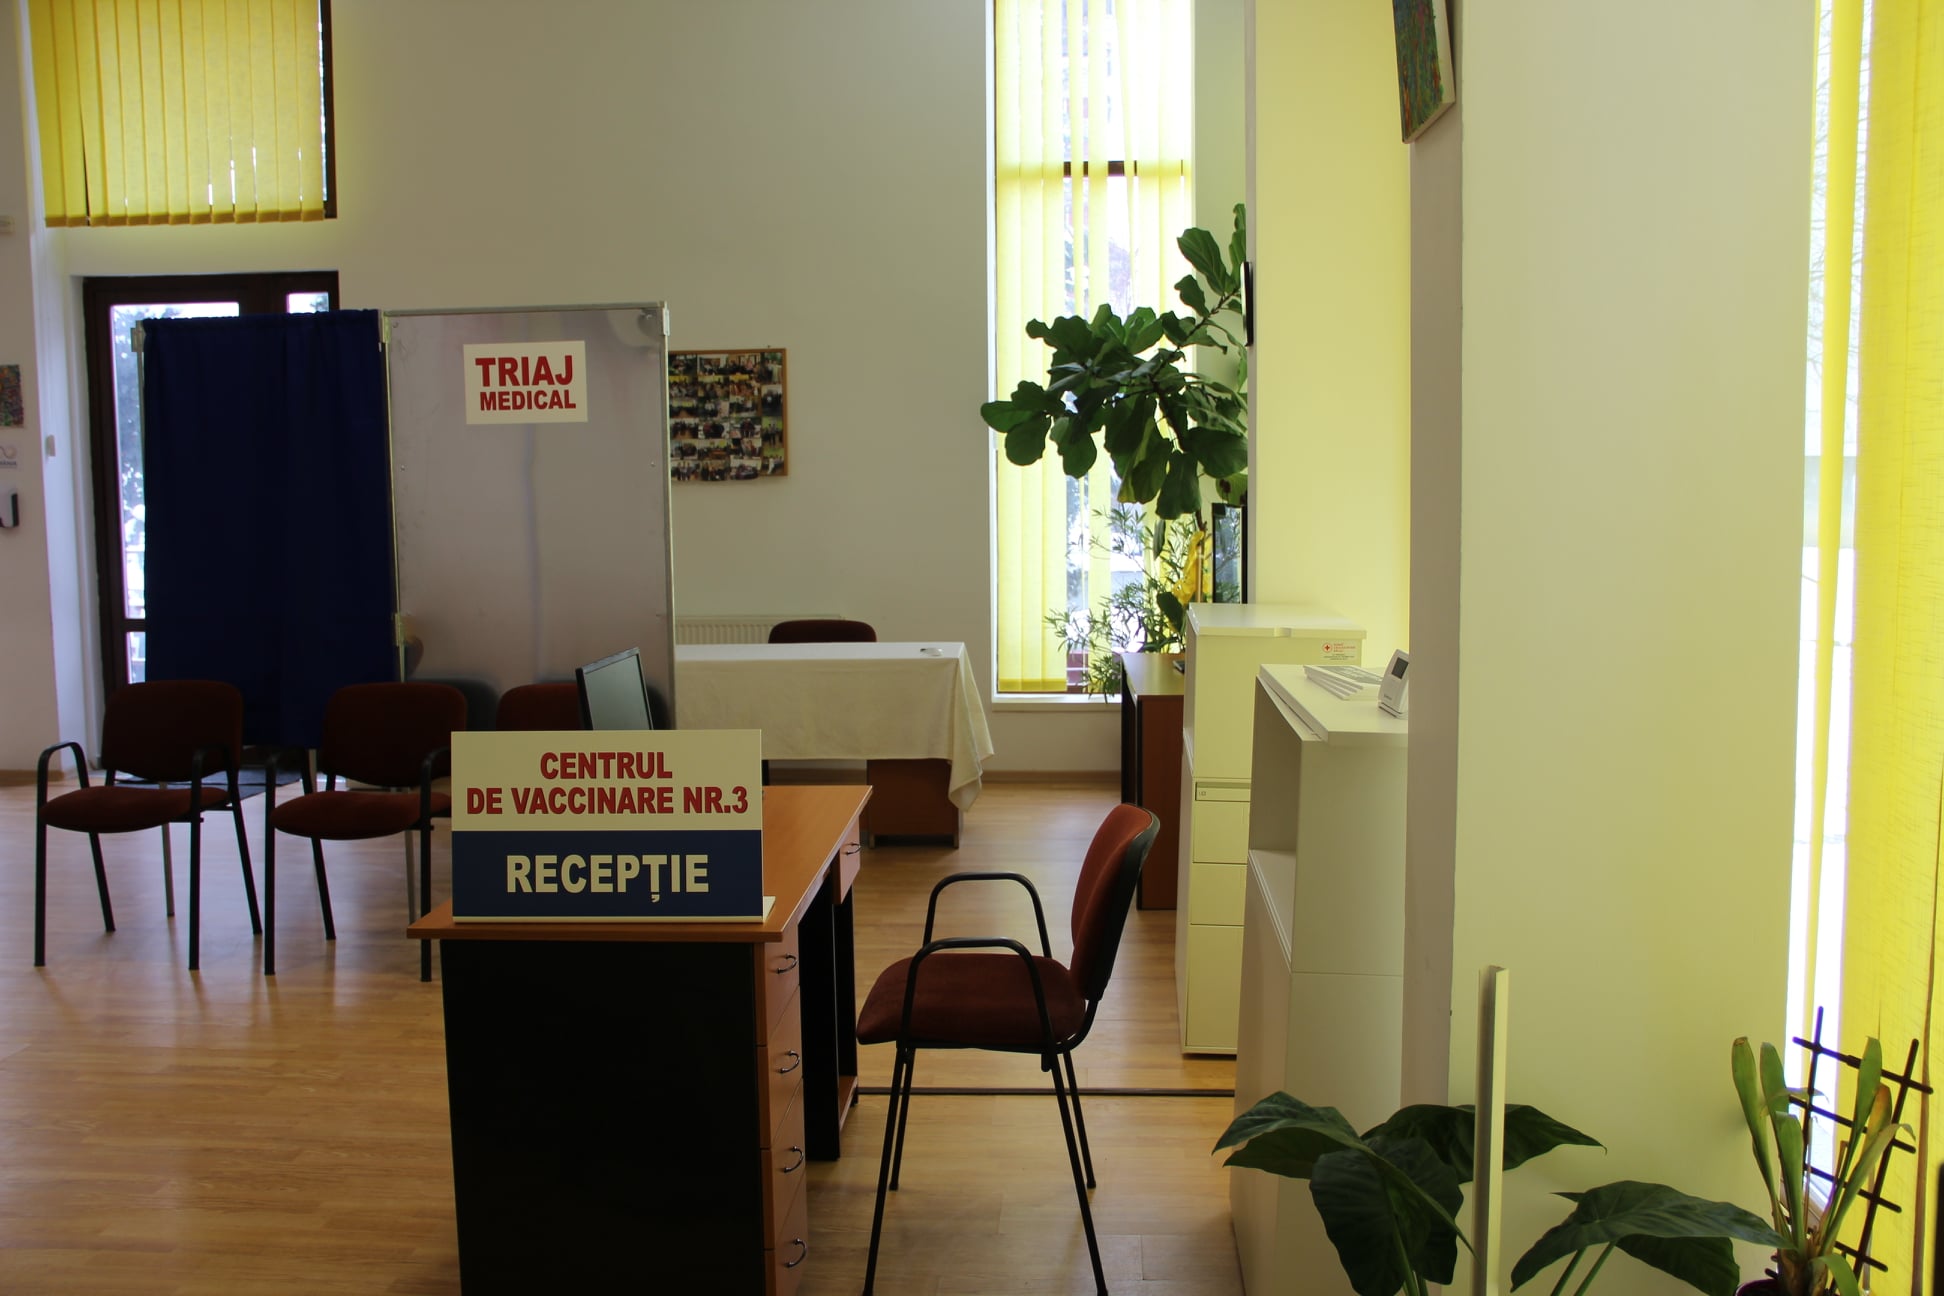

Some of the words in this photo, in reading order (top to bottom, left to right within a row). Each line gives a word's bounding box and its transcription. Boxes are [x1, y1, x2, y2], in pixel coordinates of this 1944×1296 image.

[475, 355, 573, 388] TRIAJ
[480, 390, 577, 411] MEDICAL
[540, 752, 672, 779] CENTRUL
[467, 788, 502, 815] DE
[512, 787, 673, 815] VACCINARE
[684, 786, 749, 814] NR.3
[506, 854, 709, 903] RECEPȚIE
